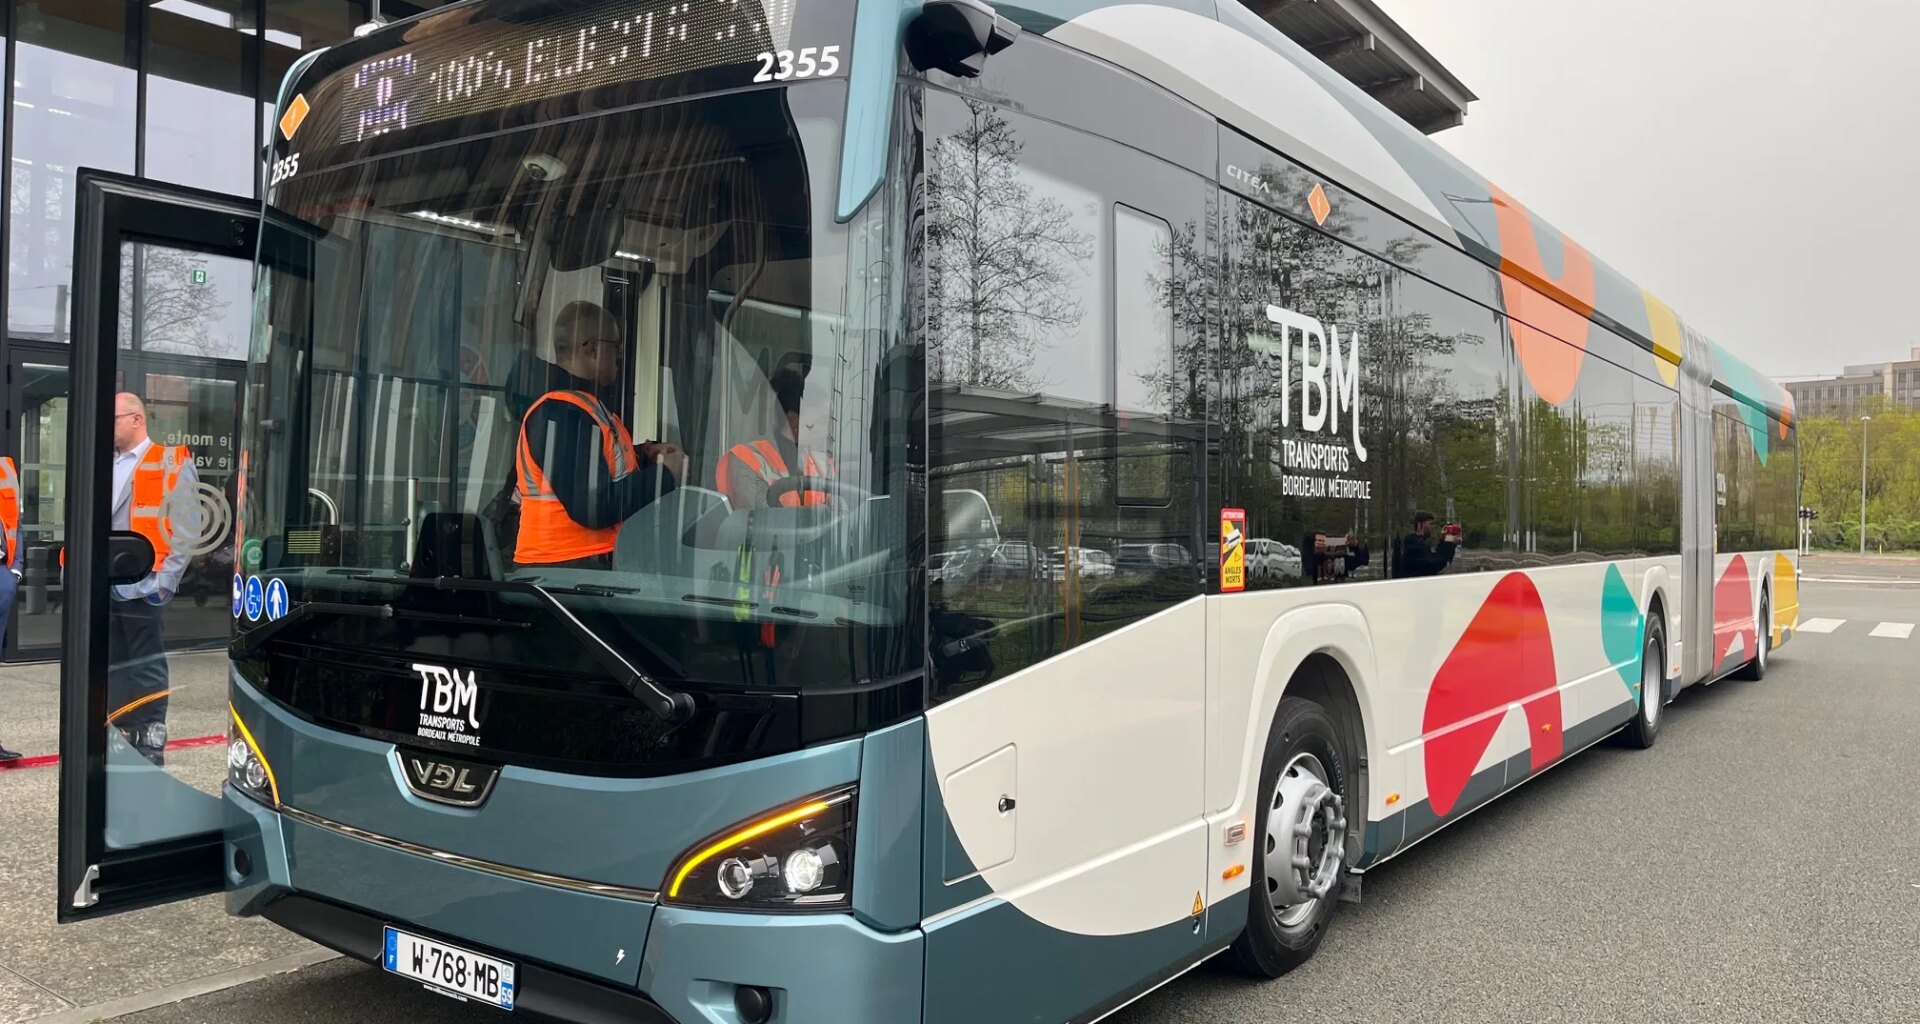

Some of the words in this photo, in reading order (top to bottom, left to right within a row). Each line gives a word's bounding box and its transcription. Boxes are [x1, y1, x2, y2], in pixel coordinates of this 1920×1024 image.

[753, 45, 840, 83] 2355
[271, 153, 300, 186] 2355
[1226, 164, 1270, 194] CITEA
[1266, 304, 1367, 463] TBM
[1282, 439, 1349, 472] TRANSPORTS
[1282, 474, 1326, 497] BORDEAUX
[1328, 475, 1372, 500] MÉTROPOLE
[1224, 566, 1242, 575] ANGLES
[1225, 575, 1241, 584] MORTS
[412, 663, 480, 730] TBM
[419, 712, 465, 733] TRANSPORTS
[417, 727, 447, 740] BORDEAUX
[447, 731, 481, 747] MÉTROPOLE
[411, 759, 476, 793] VDL
[389, 954, 395, 964] F
[501, 986, 513, 1005] 59
